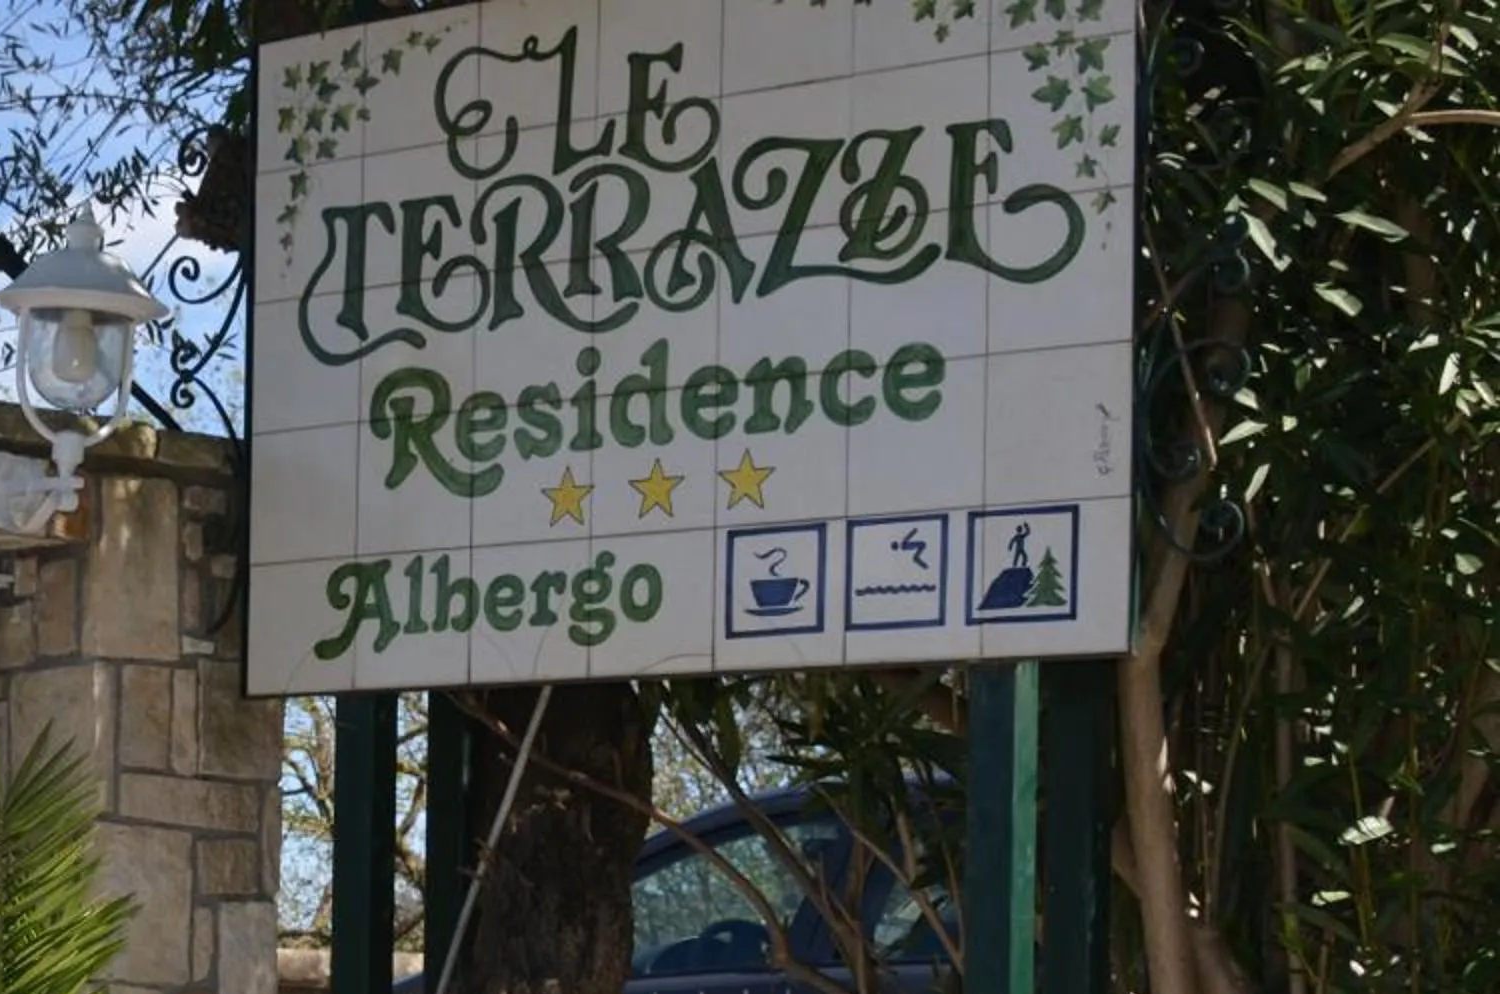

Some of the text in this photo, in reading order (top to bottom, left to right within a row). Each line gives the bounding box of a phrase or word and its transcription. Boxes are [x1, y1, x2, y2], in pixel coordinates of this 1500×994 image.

[433, 24, 722, 181] LE
[299, 117, 1087, 367] TERRAZZE
[368, 338, 947, 500] Residence
[313, 550, 663, 661] Albergo
